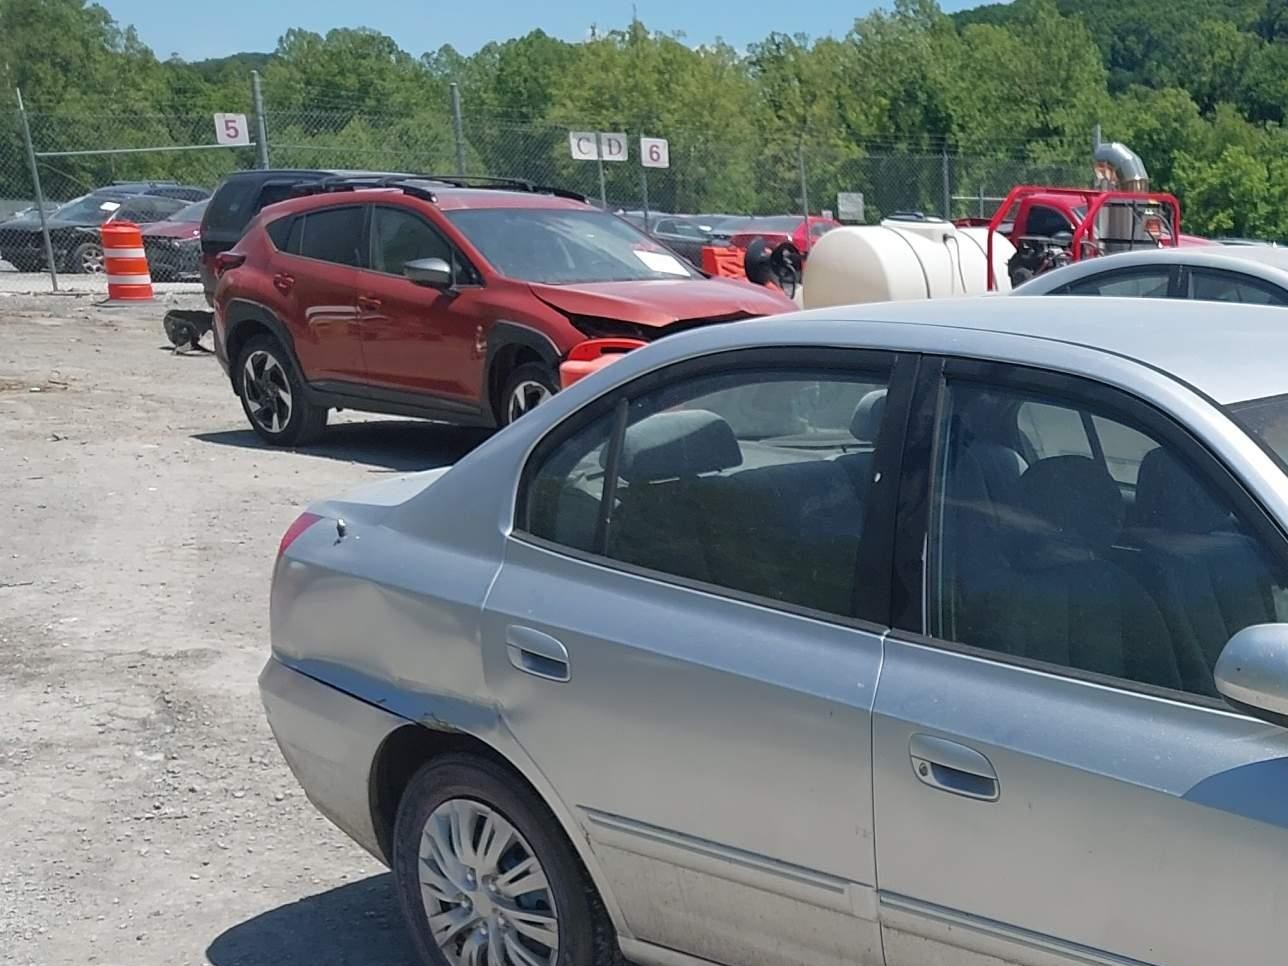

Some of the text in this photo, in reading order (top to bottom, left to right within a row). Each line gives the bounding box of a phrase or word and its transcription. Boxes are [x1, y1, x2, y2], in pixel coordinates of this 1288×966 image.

[224, 119, 240, 139] 5
[576, 136, 592, 155] C
[607, 138, 623, 156] D
[648, 144, 661, 162] 6
